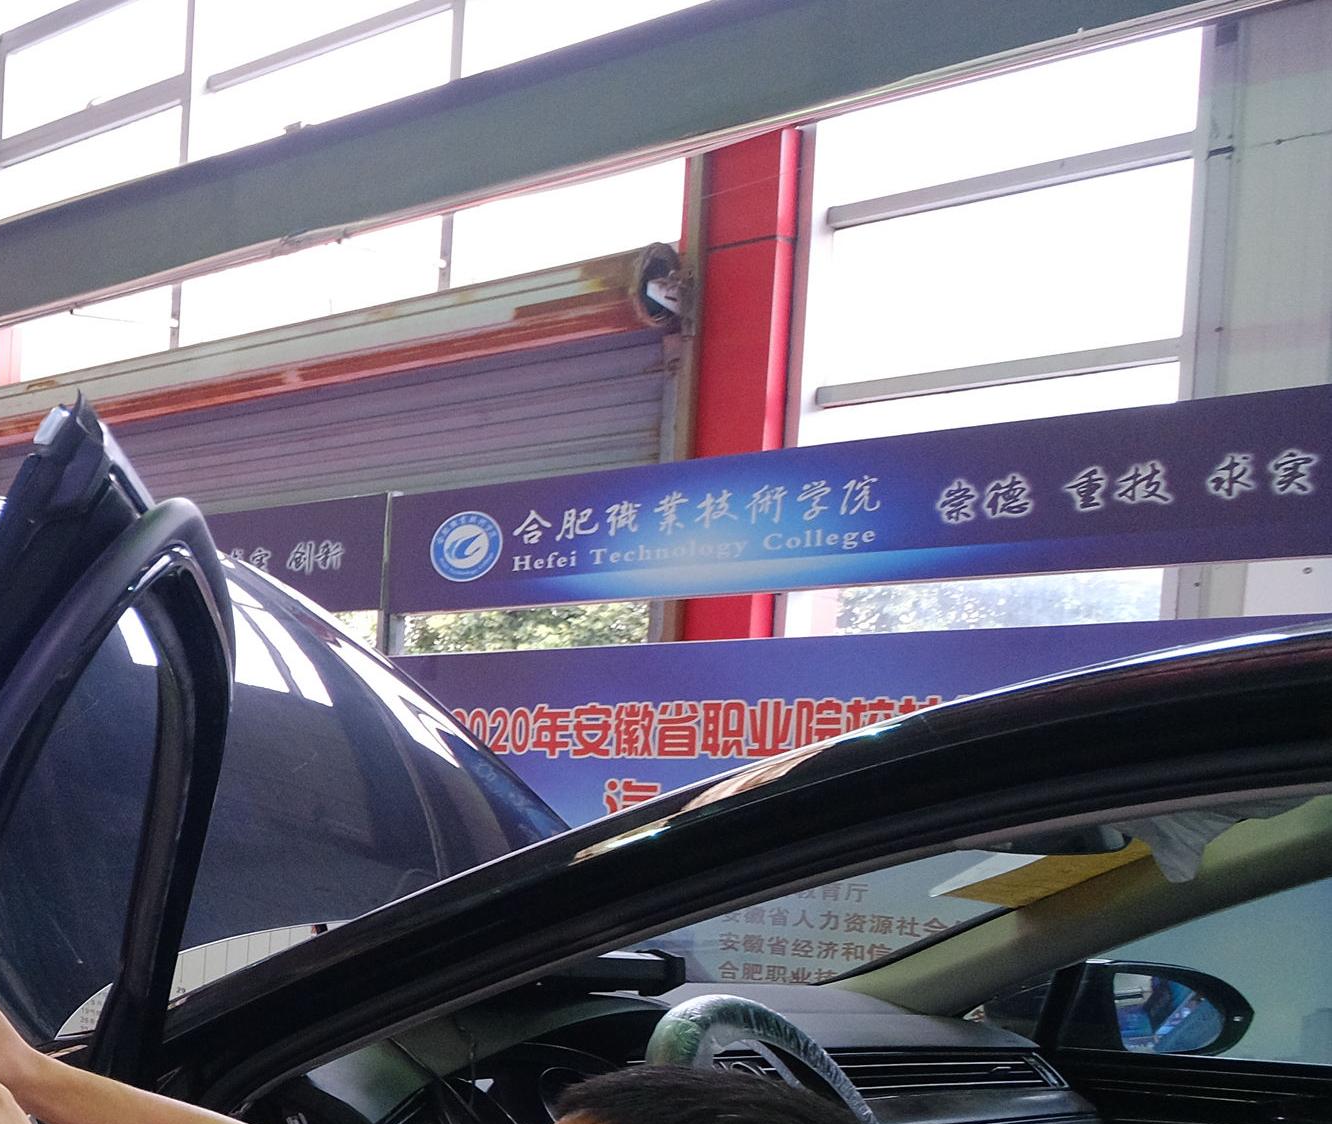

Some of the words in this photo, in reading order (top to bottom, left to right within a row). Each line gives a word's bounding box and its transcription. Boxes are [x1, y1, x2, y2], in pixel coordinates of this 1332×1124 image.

[938, 477, 1033, 523] 崇德
[1066, 462, 1171, 510] 重技
[1208, 450, 1314, 498] 求实
[286, 540, 345, 575] 创新
[511, 551, 578, 572] Hefei
[589, 538, 748, 566] Technology
[762, 528, 877, 551] College
[721, 907, 963, 938] 安徽省人力资源社会
